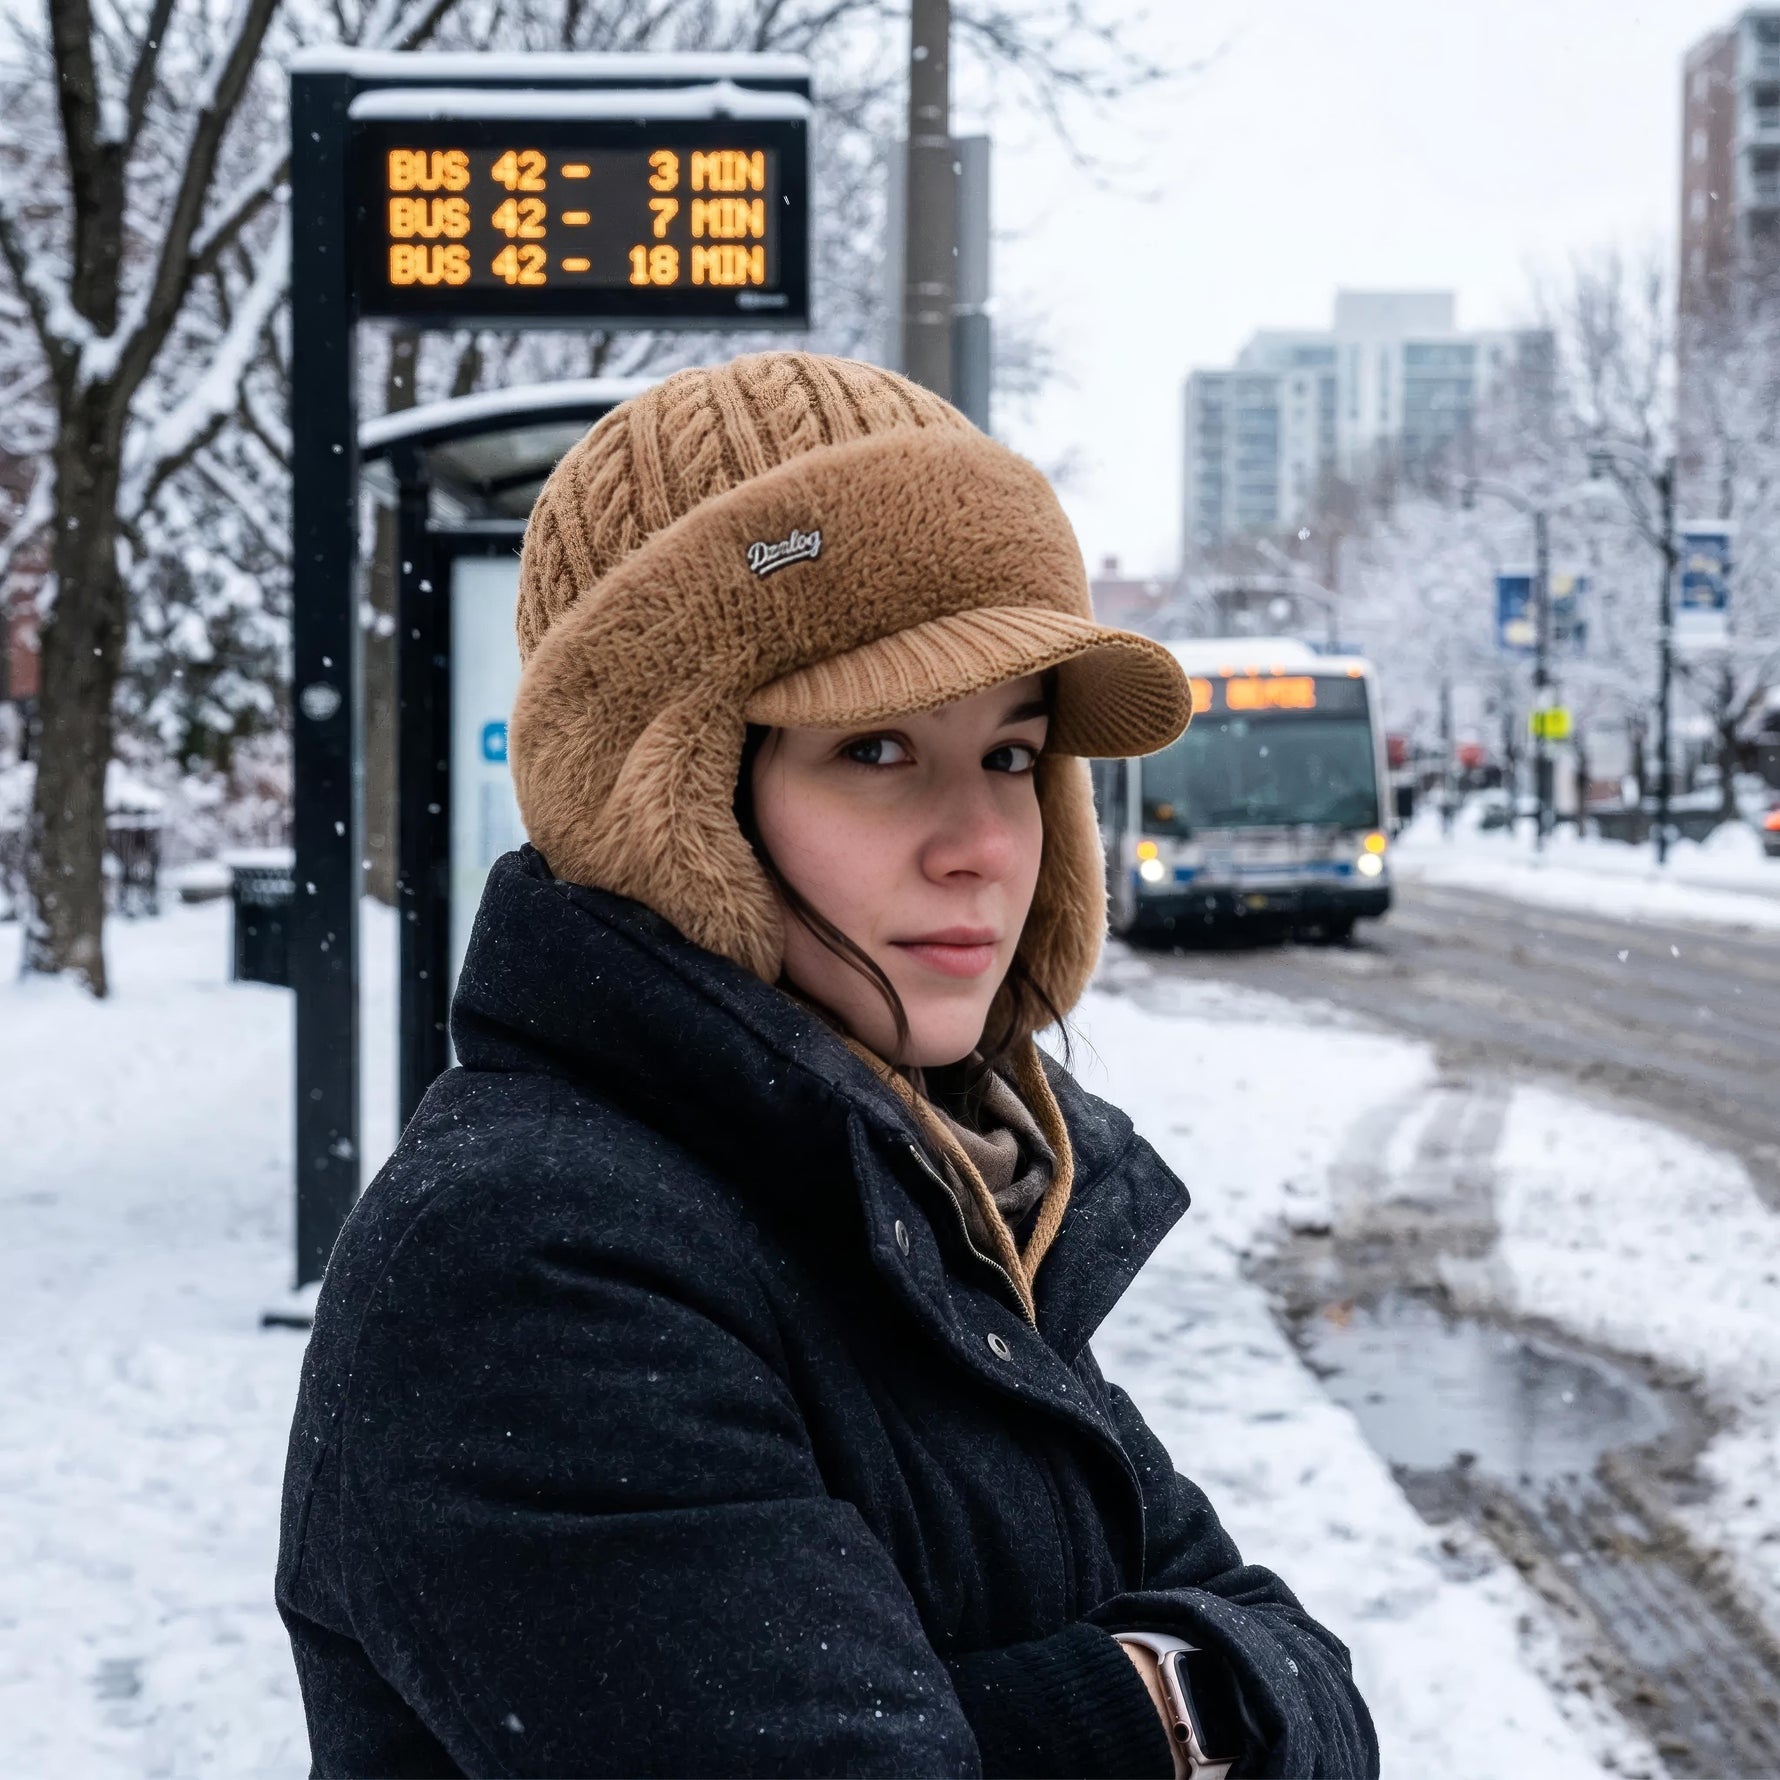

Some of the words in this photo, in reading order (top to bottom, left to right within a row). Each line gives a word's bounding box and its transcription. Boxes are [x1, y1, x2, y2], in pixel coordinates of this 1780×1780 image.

[388, 150, 471, 191] BUS
[491, 150, 547, 191] 42
[649, 150, 679, 191] 3
[691, 150, 765, 191] MIN
[388, 197, 471, 238] BUS
[491, 197, 547, 238] 42
[649, 197, 679, 238] 7
[691, 197, 765, 238] MIN
[388, 244, 471, 285] BUS
[491, 244, 547, 285] 42
[629, 244, 679, 285] 18
[691, 244, 765, 285] MIN
